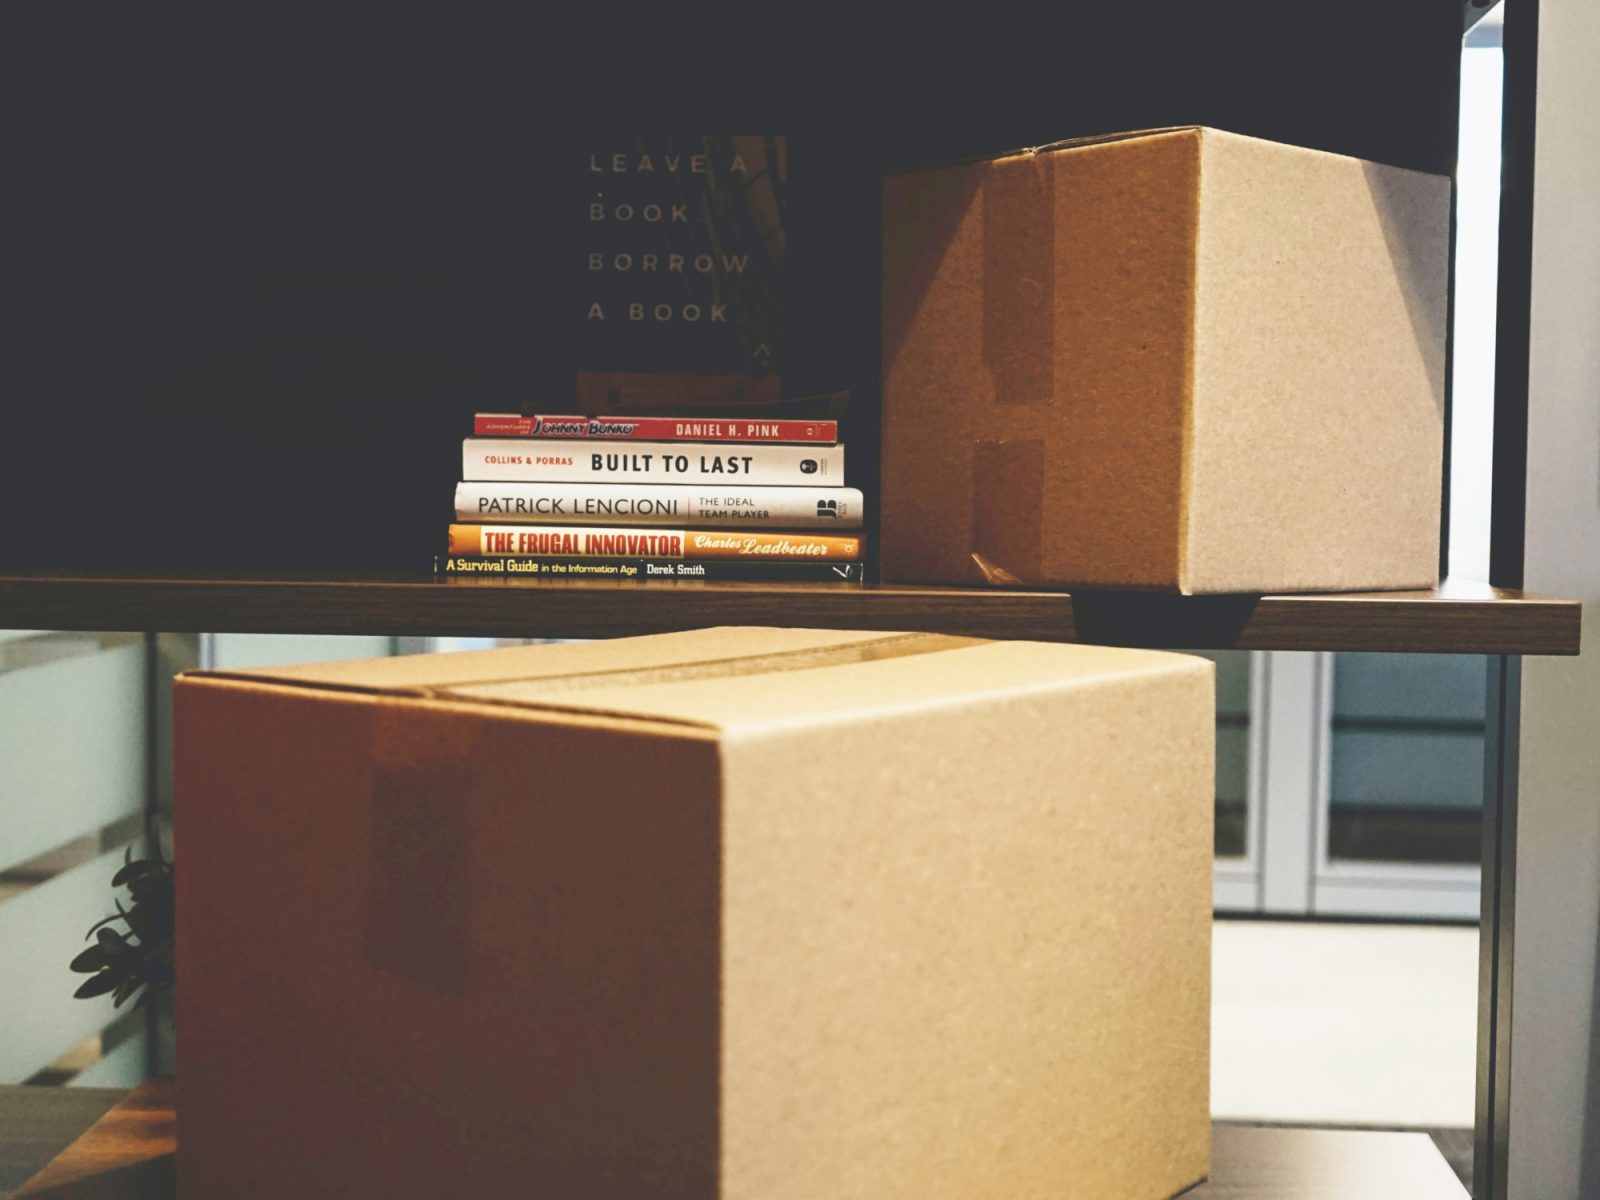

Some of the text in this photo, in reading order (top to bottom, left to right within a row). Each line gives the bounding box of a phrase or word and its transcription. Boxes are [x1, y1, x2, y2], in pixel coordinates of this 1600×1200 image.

[590, 154, 747, 173] LEAVE A
[588, 253, 748, 273] BORROW
[587, 303, 605, 321] A
[588, 419, 636, 435] BUNKO
[676, 423, 779, 437] DANIEL H. PINK
[485, 455, 573, 466] COLLINS & PORRAS
[591, 453, 753, 474] BUILT TO LAST
[478, 497, 678, 515] PATRICK LENCIONI
[699, 497, 755, 507] THE IDEAL
[699, 509, 769, 519] TEAM PLAYER
[484, 532, 681, 556] THE FRUGAL INNOVATOR
[694, 535, 828, 556] Charles Leadbeater
[446, 559, 637, 576] A Survival Guide in the Information Age
[646, 564, 705, 575] Derek Smith
